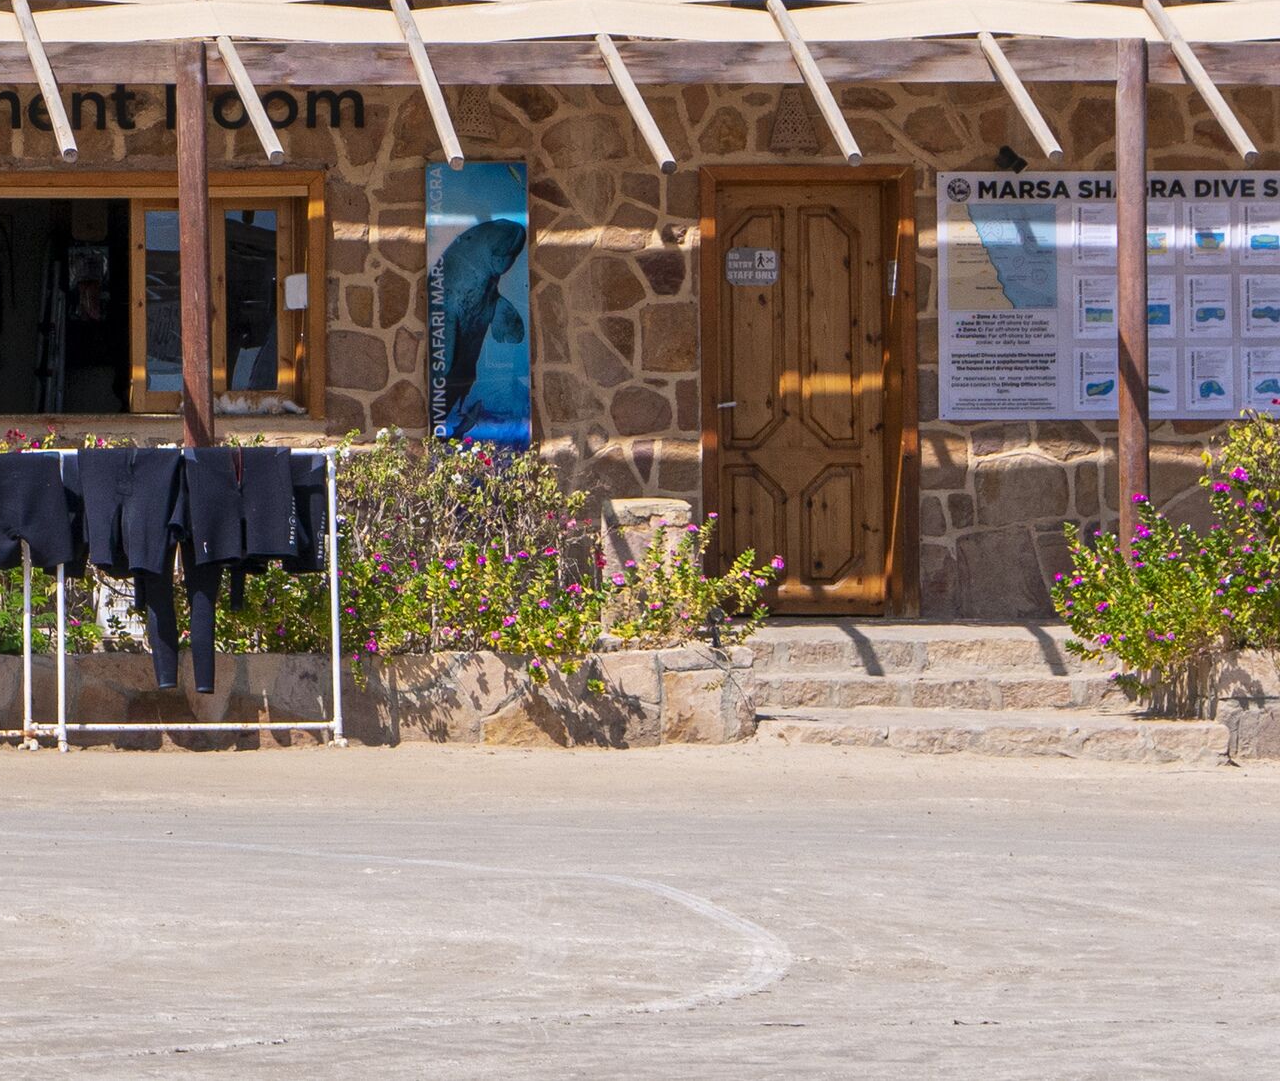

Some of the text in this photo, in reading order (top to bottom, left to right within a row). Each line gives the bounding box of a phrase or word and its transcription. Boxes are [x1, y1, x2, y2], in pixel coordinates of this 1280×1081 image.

[977, 179, 1071, 199] MARSA
[1077, 179, 1187, 199] SHRA
[1194, 179, 1256, 198] DIVE
[431, 254, 445, 306] MARS
[727, 271, 778, 279] STAFF ONLY
[728, 261, 753, 269] ENTRY
[432, 310, 446, 371] SAFARI
[433, 377, 447, 437] DIVING
